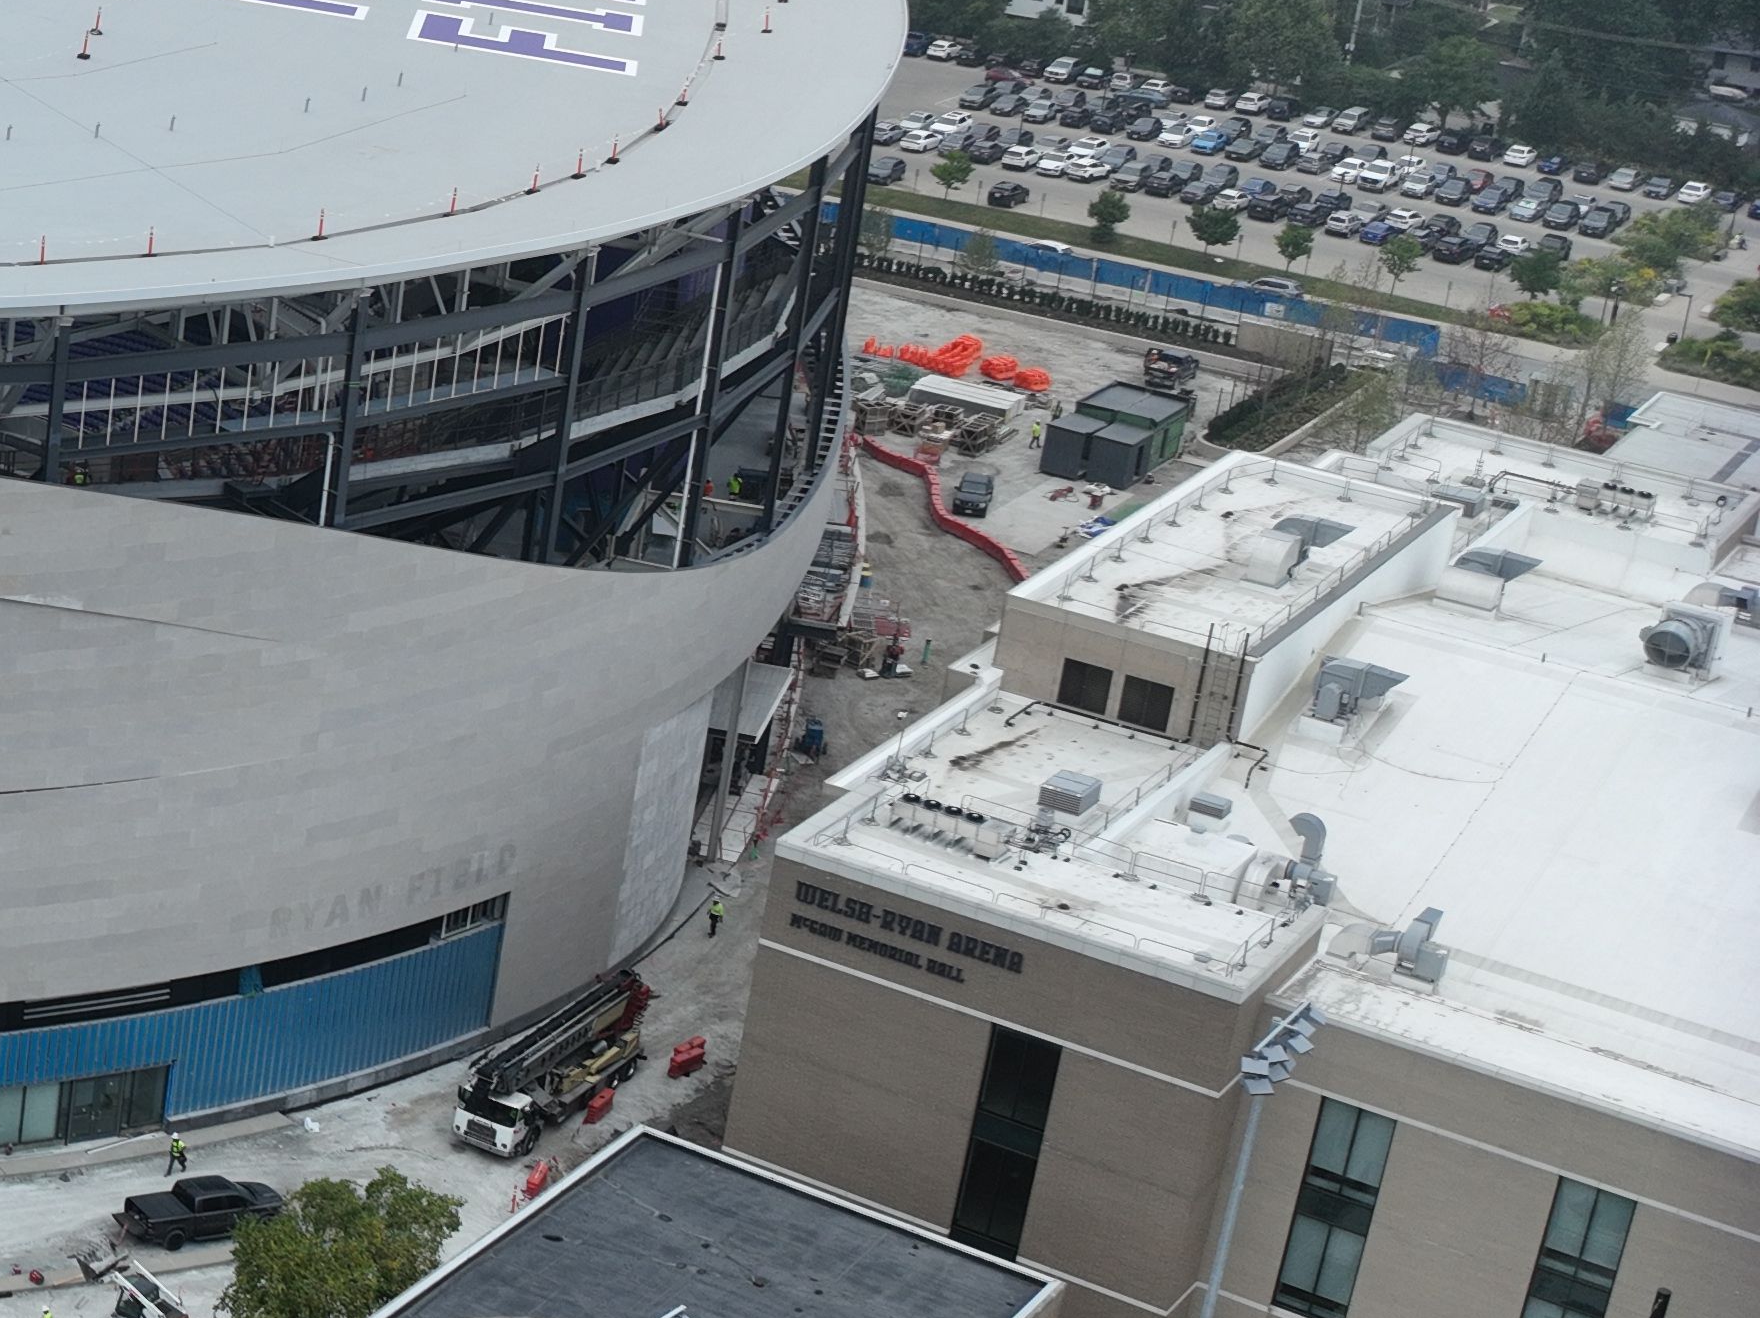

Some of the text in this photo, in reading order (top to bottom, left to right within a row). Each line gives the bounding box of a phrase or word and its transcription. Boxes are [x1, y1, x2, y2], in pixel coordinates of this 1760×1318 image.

[269, 883, 385, 939] RYAN
[795, 880, 1024, 974] WELSH-RYAN ARENA
[789, 912, 965, 984] McGAW MEMORIAL HALL
